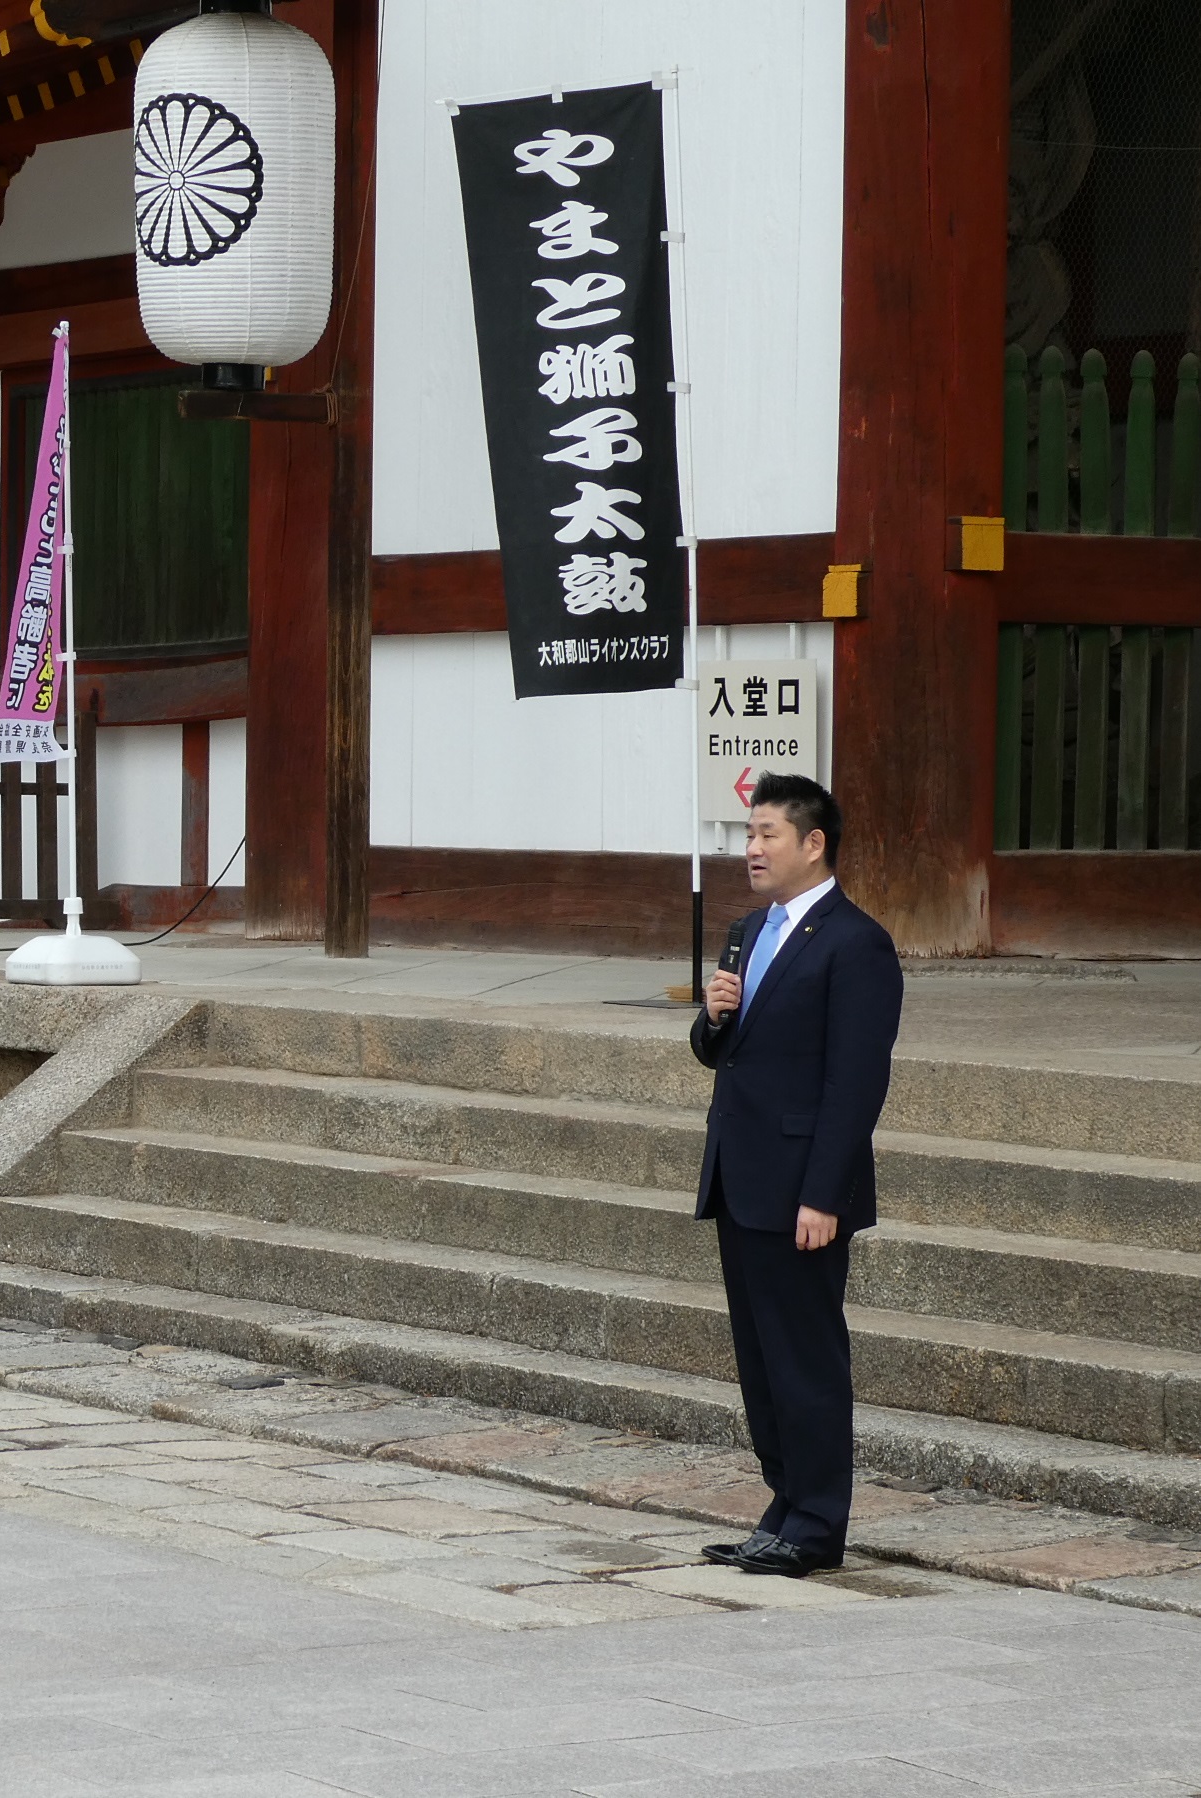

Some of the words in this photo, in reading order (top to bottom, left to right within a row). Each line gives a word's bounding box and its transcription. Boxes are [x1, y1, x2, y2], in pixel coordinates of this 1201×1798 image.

[513, 128, 649, 616] やまと獅子太鼓
[537, 634, 670, 667] 大和郡山ライオンズクラブ
[709, 676, 800, 717] 入堂口
[709, 734, 799, 756] Entrance
